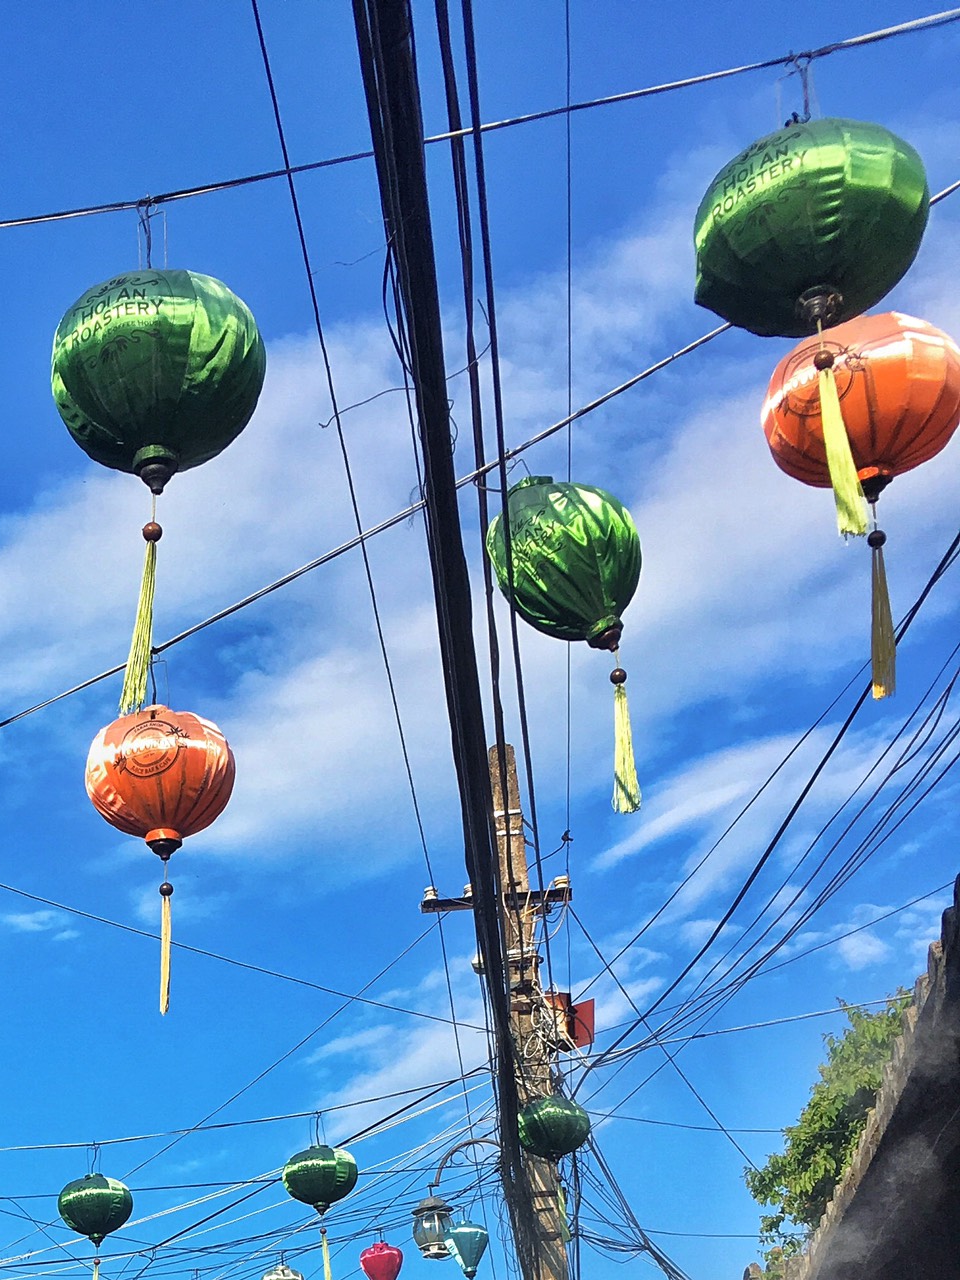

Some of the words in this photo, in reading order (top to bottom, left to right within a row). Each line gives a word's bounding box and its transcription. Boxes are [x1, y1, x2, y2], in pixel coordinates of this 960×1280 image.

[711, 150, 808, 225] ROASTERY
[722, 164, 754, 197] HOI
[760, 145, 790, 168] AN
[70, 299, 164, 347] ROASTERY
[82, 296, 110, 324] HOI
[117, 288, 146, 300] AN
